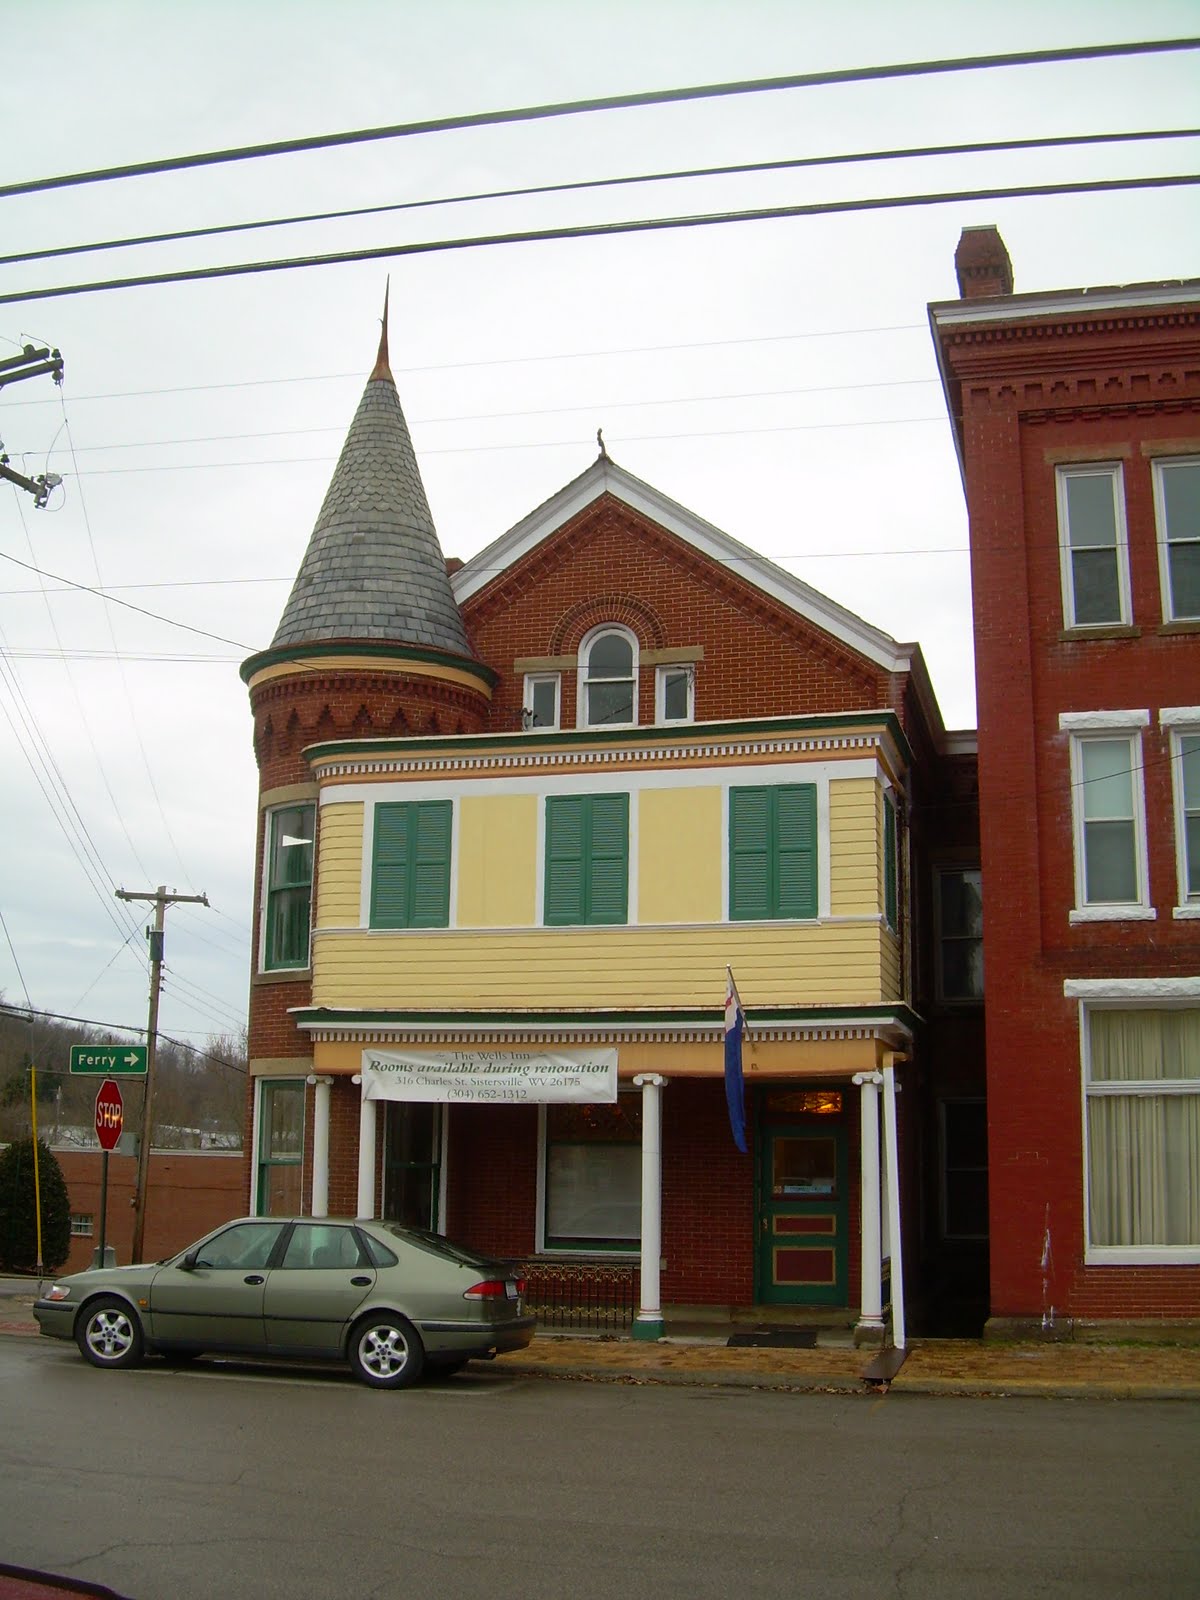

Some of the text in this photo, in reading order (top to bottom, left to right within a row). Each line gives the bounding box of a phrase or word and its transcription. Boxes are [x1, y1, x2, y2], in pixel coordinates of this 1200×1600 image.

[78, 1054, 116, 1068] Ferry
[452, 1051, 530, 1060] The Wells Inn
[368, 1060, 609, 1076] Rooms available during renovation
[395, 1076, 581, 1087] 316 Charles St. Sistersville WV 26175
[447, 1089, 527, 1100] (304) 652-1312
[97, 1101, 121, 1129] STOP
